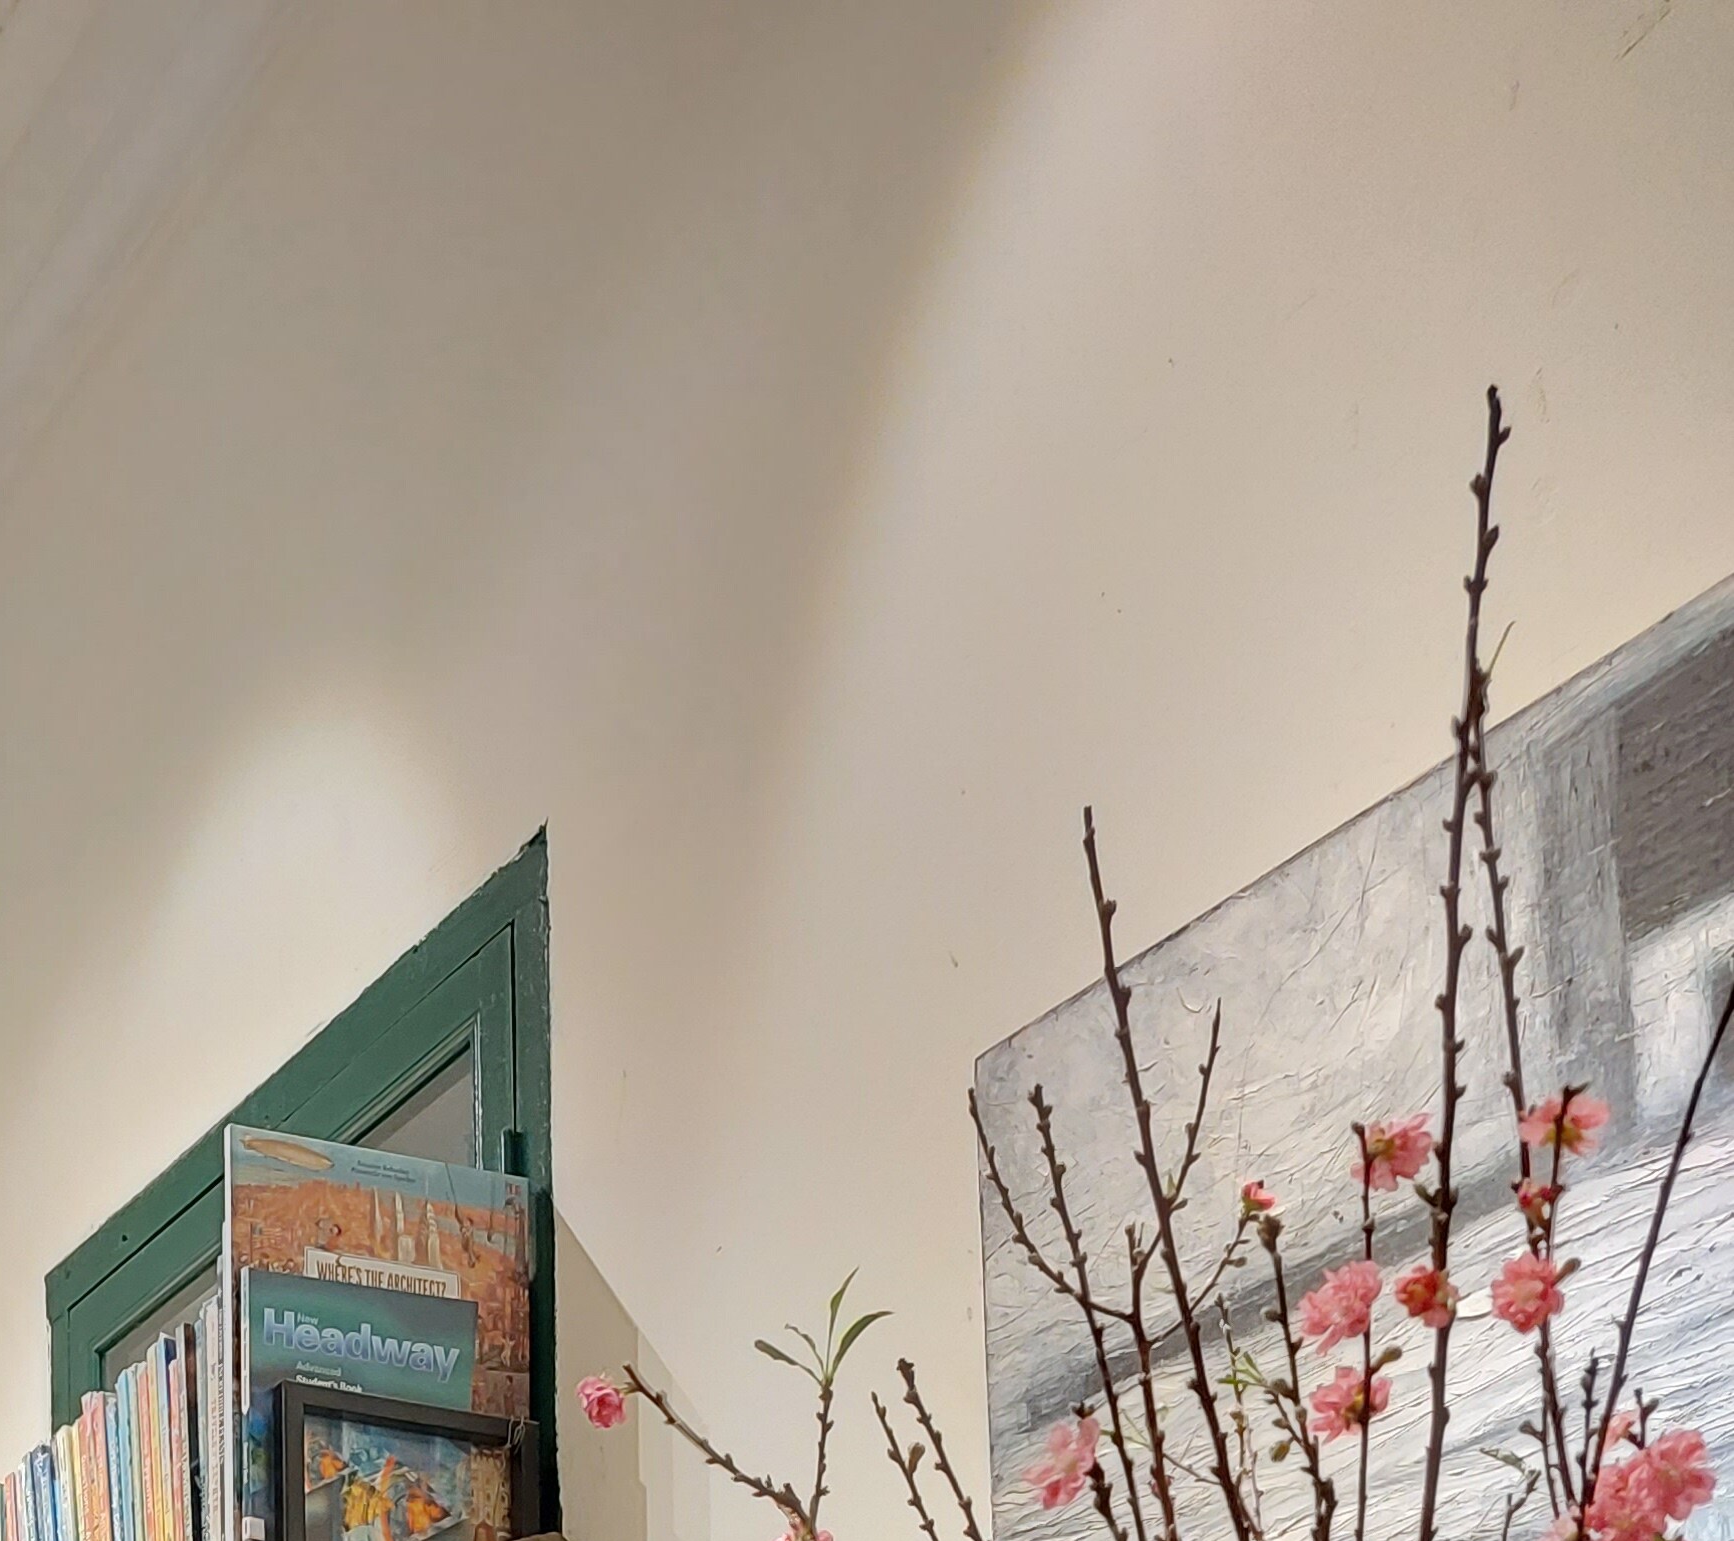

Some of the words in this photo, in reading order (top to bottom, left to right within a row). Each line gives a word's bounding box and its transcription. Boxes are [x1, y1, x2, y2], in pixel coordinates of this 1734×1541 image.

[317, 1261, 362, 1285] WHERE'S
[365, 1269, 384, 1288] THE
[387, 1273, 446, 1297] ARCHITECT?
[297, 1312, 319, 1325] New
[264, 1307, 460, 1383] Headway
[296, 1361, 342, 1377] Advanced
[296, 1375, 339, 1390] Student's
[340, 1381, 363, 1393] Book
